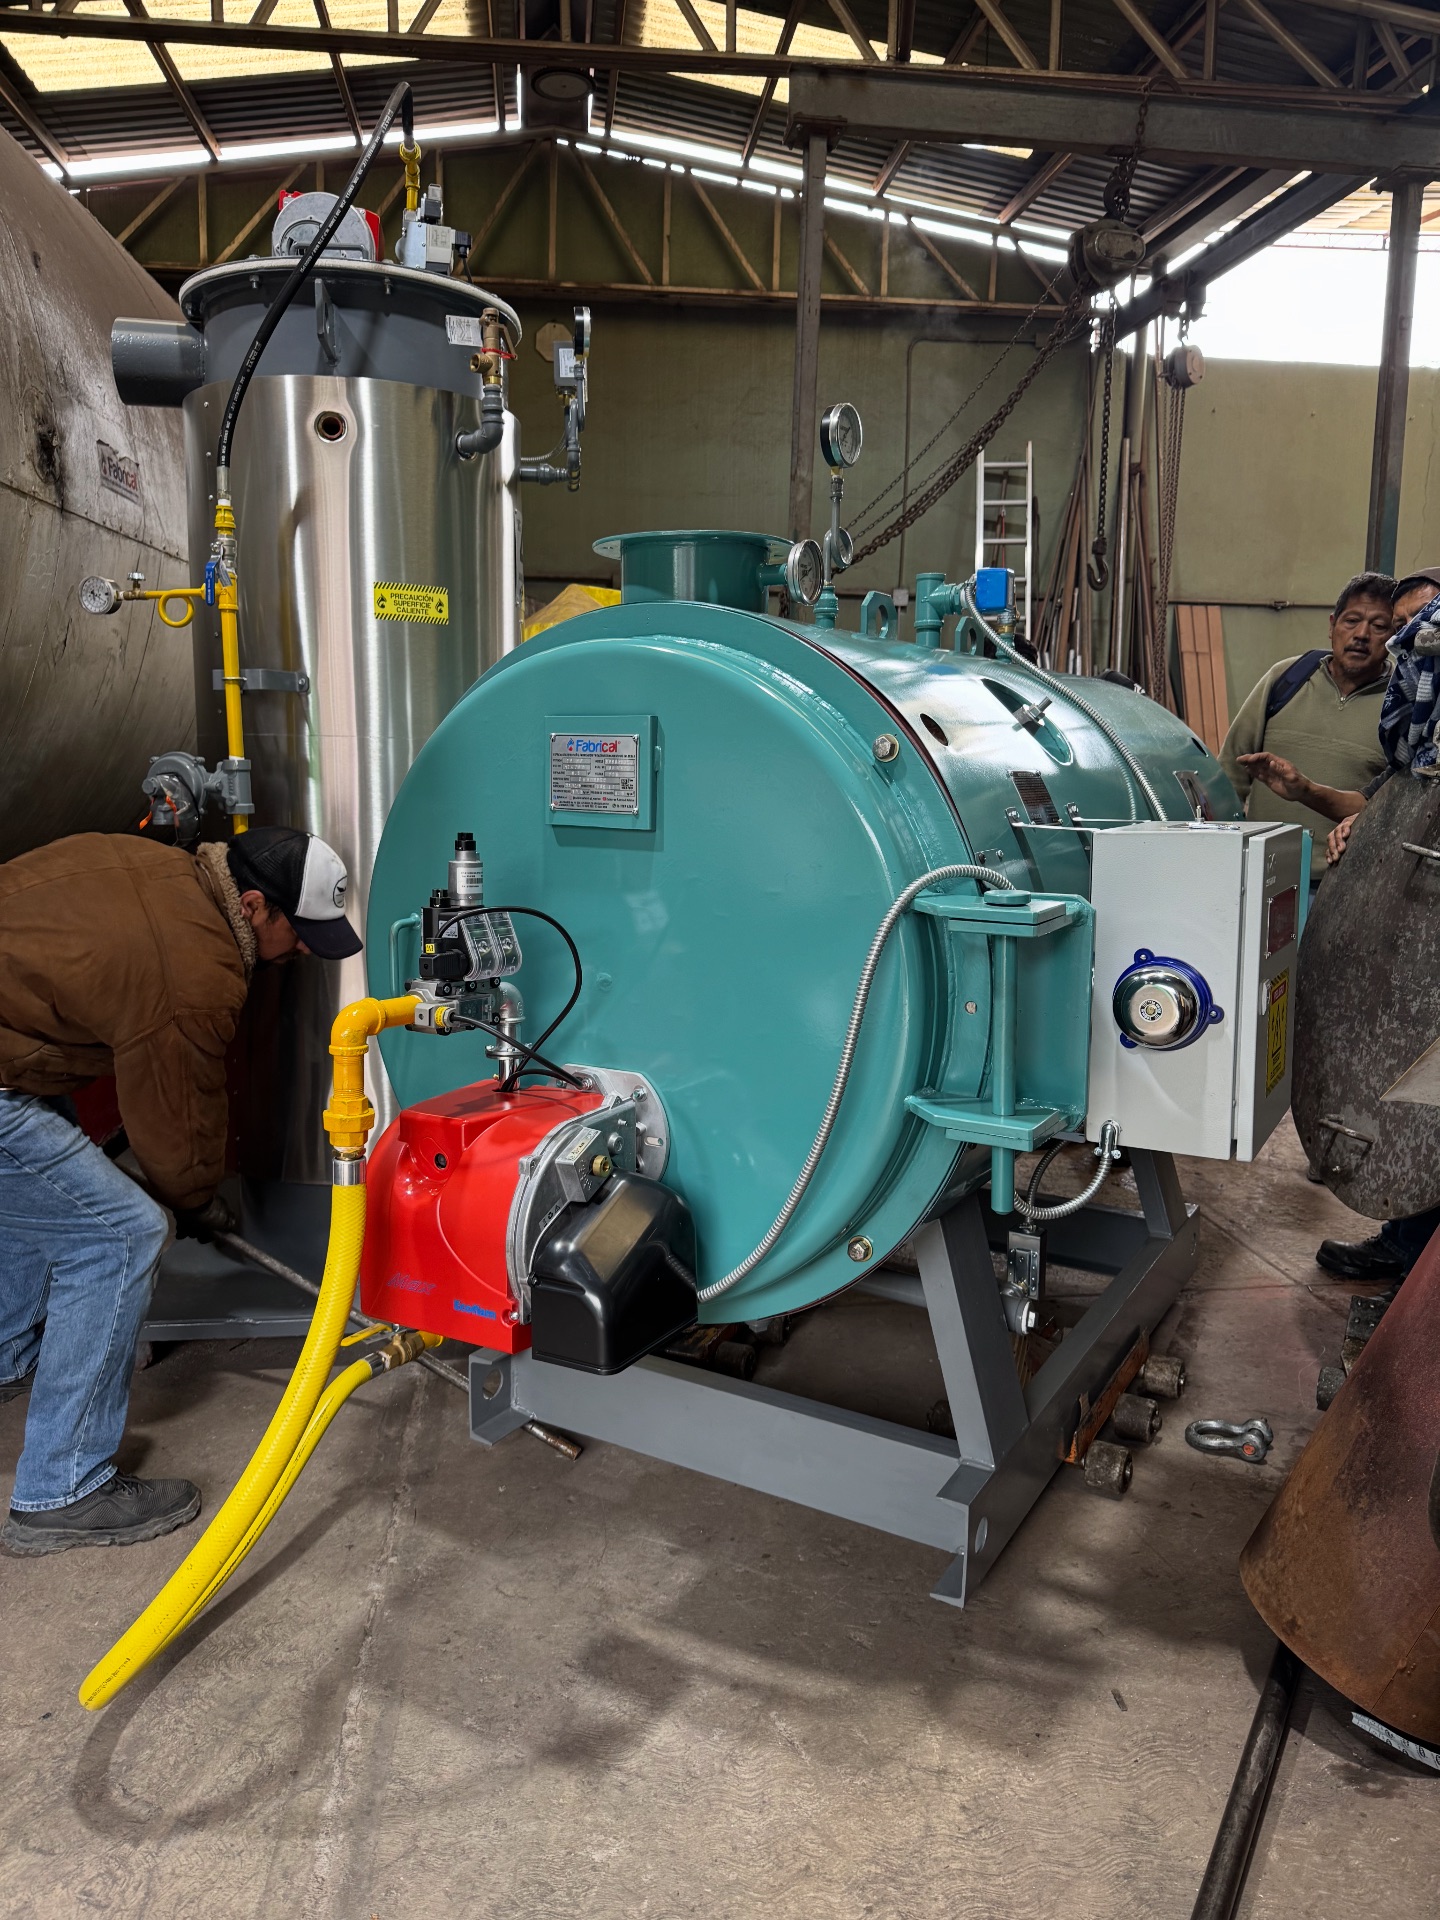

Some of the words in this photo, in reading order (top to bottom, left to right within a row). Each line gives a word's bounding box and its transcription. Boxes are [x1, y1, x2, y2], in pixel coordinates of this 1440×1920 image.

[390, 593, 434, 602] PRECAUCIÓN
[393, 600, 432, 609] SUPERFICIE
[396, 607, 429, 615] CALIENTE
[576, 739, 617, 752] Fabrical
[386, 1272, 437, 1295] Max
